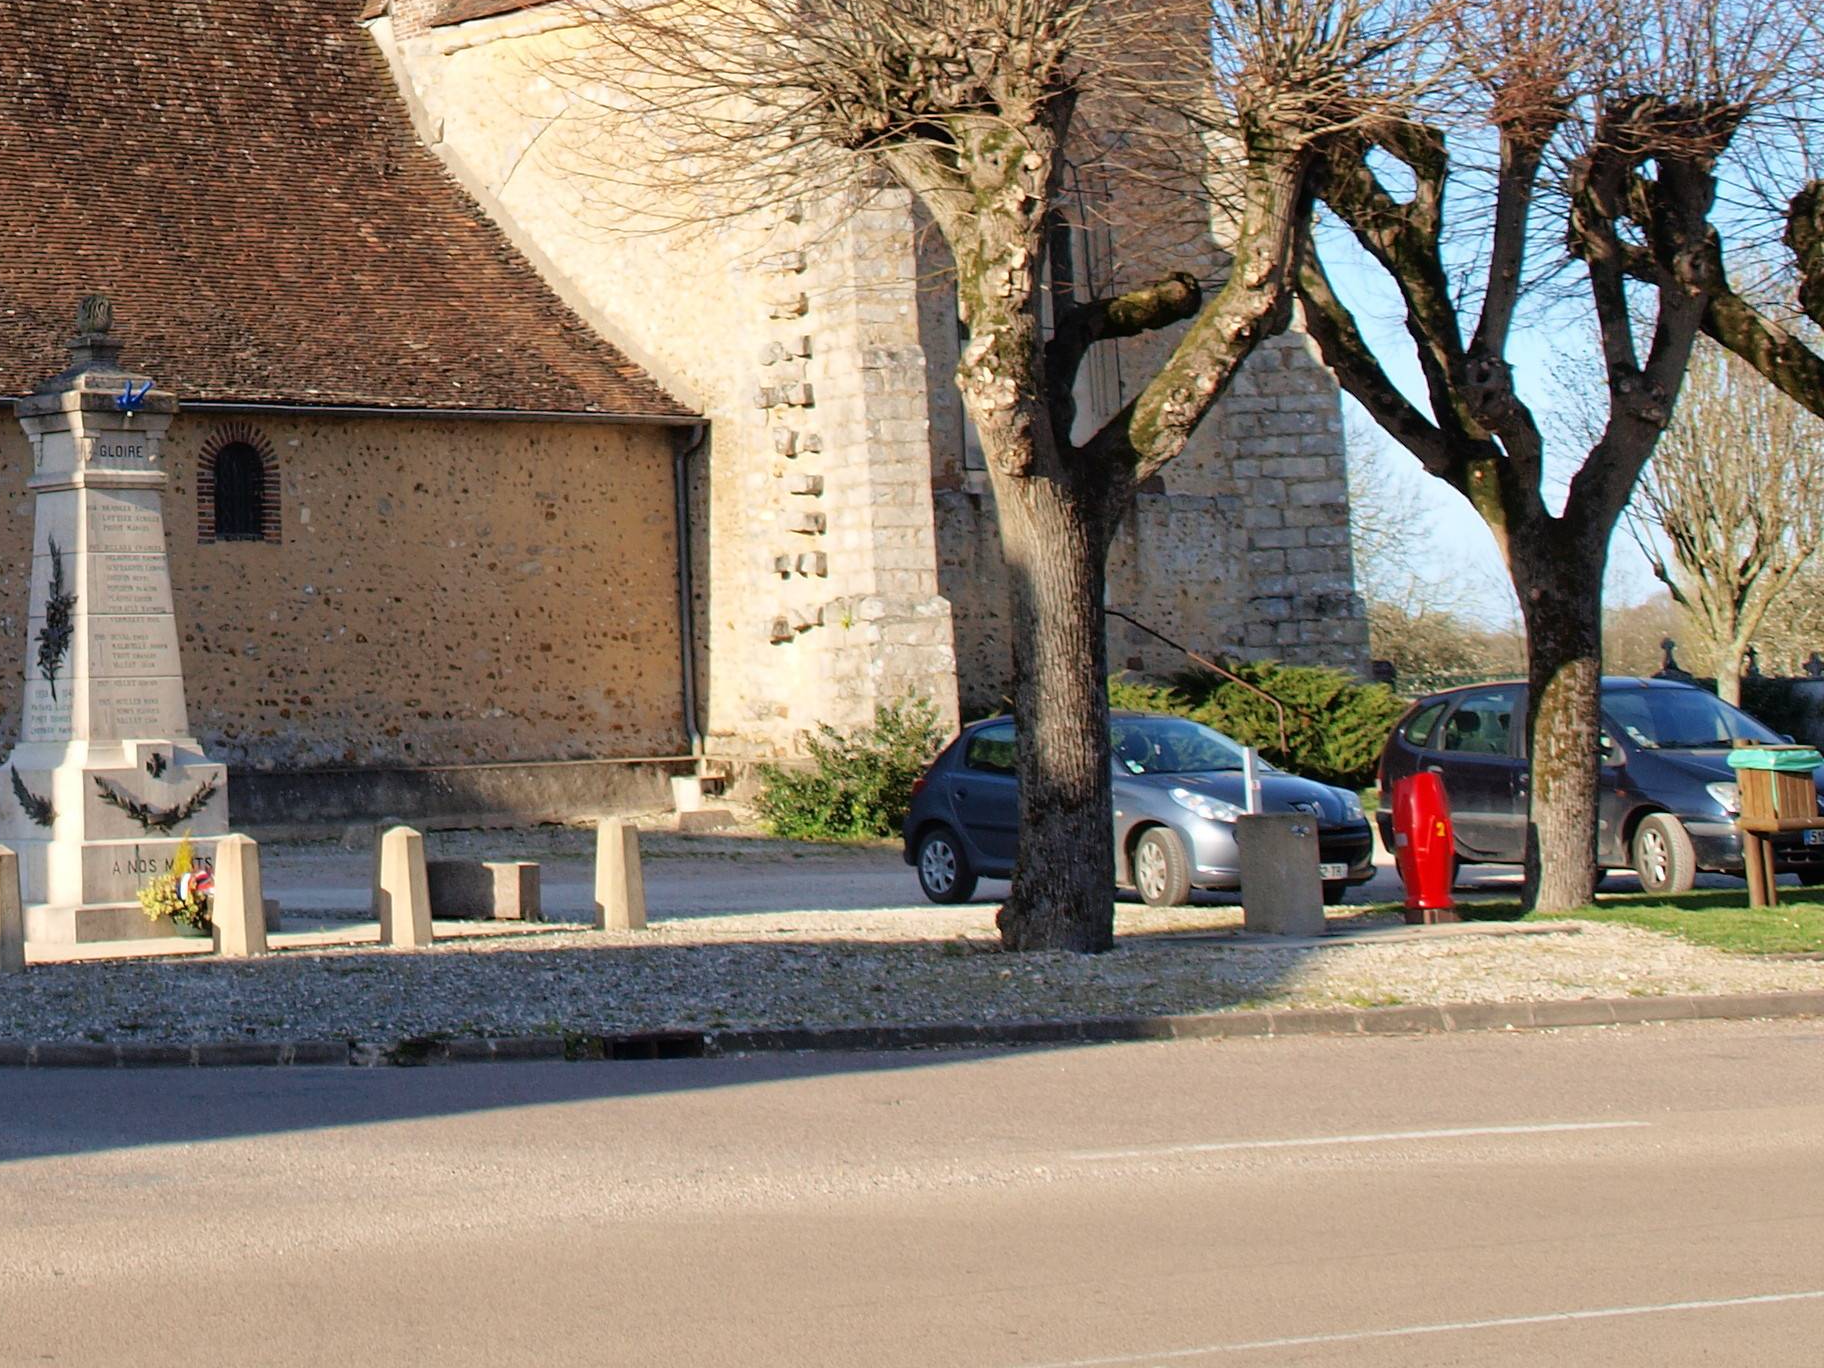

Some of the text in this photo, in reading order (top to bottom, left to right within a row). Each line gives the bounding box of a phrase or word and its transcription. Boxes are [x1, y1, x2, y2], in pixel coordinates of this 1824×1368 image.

[99, 444, 144, 459] GLOIRE
[113, 857, 213, 875] A NOS MTS
